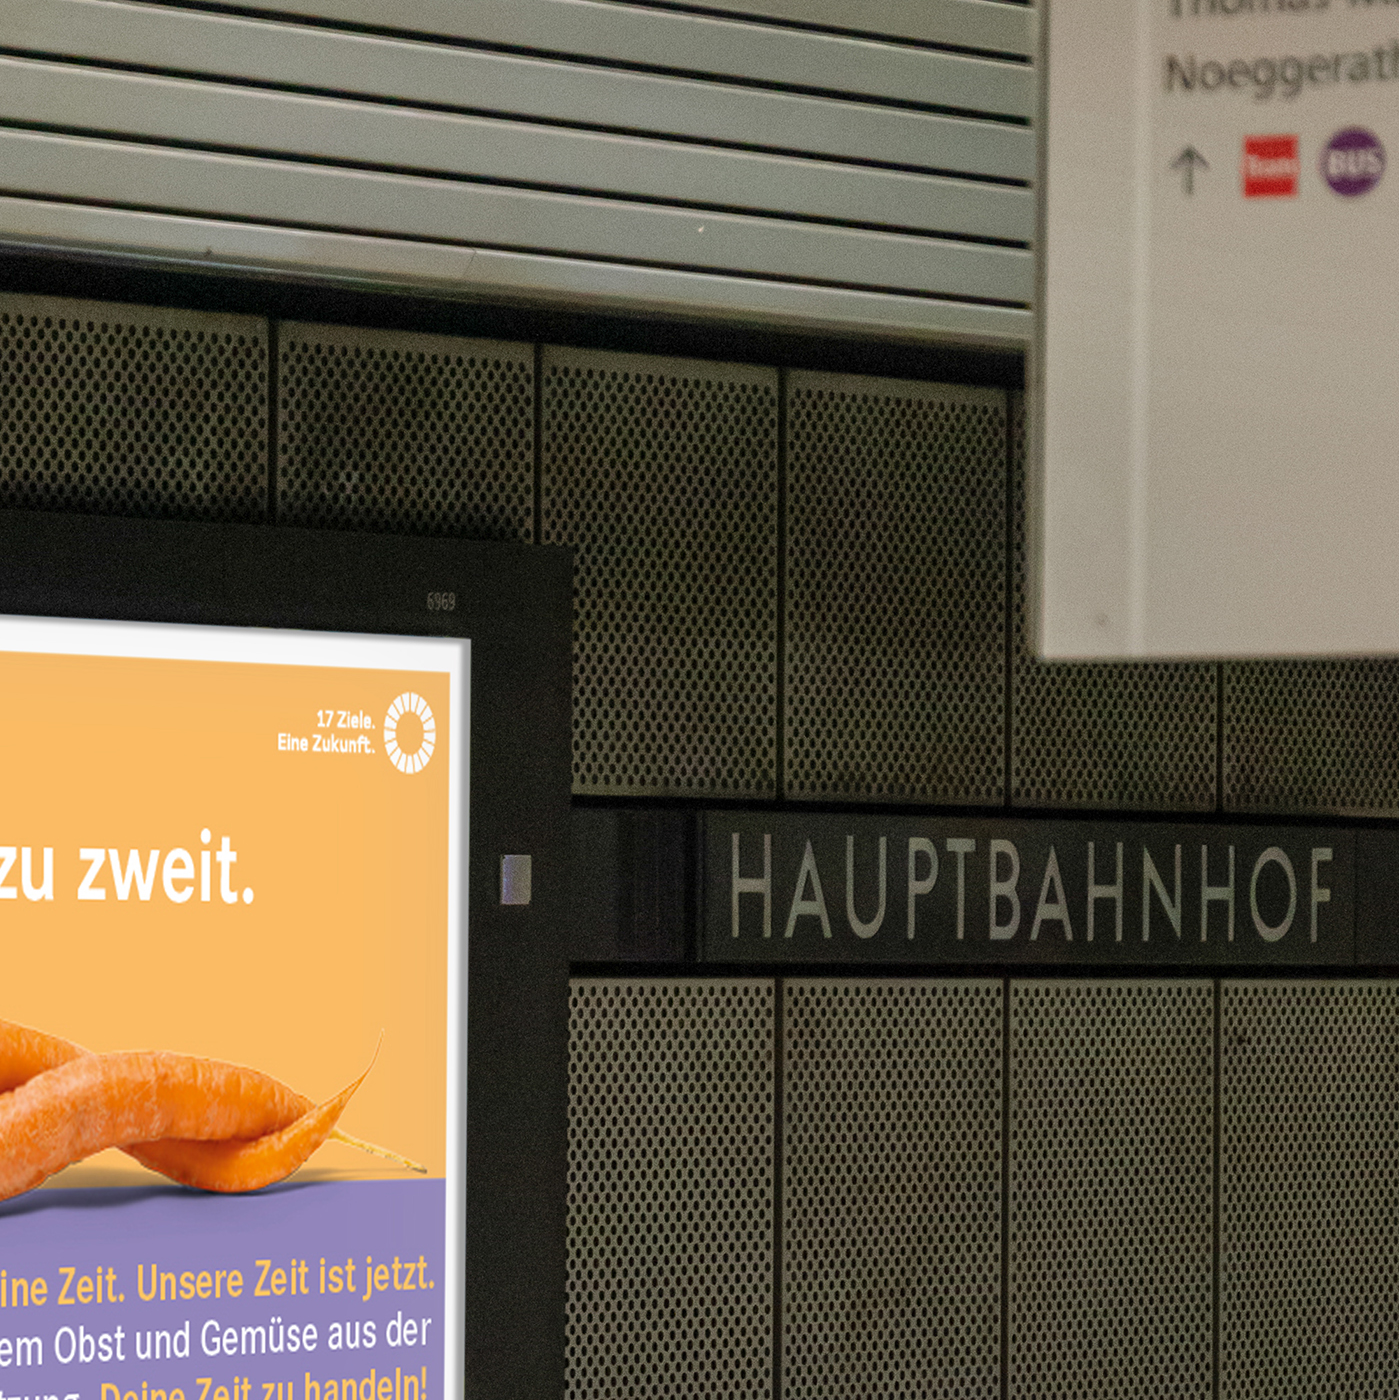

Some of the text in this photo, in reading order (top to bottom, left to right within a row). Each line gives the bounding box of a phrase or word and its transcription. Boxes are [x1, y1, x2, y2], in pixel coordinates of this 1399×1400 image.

[1327, 150, 1384, 176] BUS
[426, 592, 456, 611] 6969
[316, 709, 376, 729] 17 Ziele.
[277, 732, 376, 754] Eine Zukunft.
[77, 827, 255, 905] zweit.
[731, 832, 1334, 943] HAUPTBAHNHOF
[57, 1265, 125, 1305] Zeit.
[137, 1263, 244, 1301] Unsere
[254, 1258, 309, 1296] Zeit
[319, 1257, 356, 1294] ist
[362, 1255, 435, 1302] jetzt.
[54, 1325, 126, 1364] Obst
[135, 1320, 190, 1360] und
[200, 1316, 318, 1357] Gemüse
[327, 1320, 377, 1351] aus
[385, 1310, 432, 1347] der
